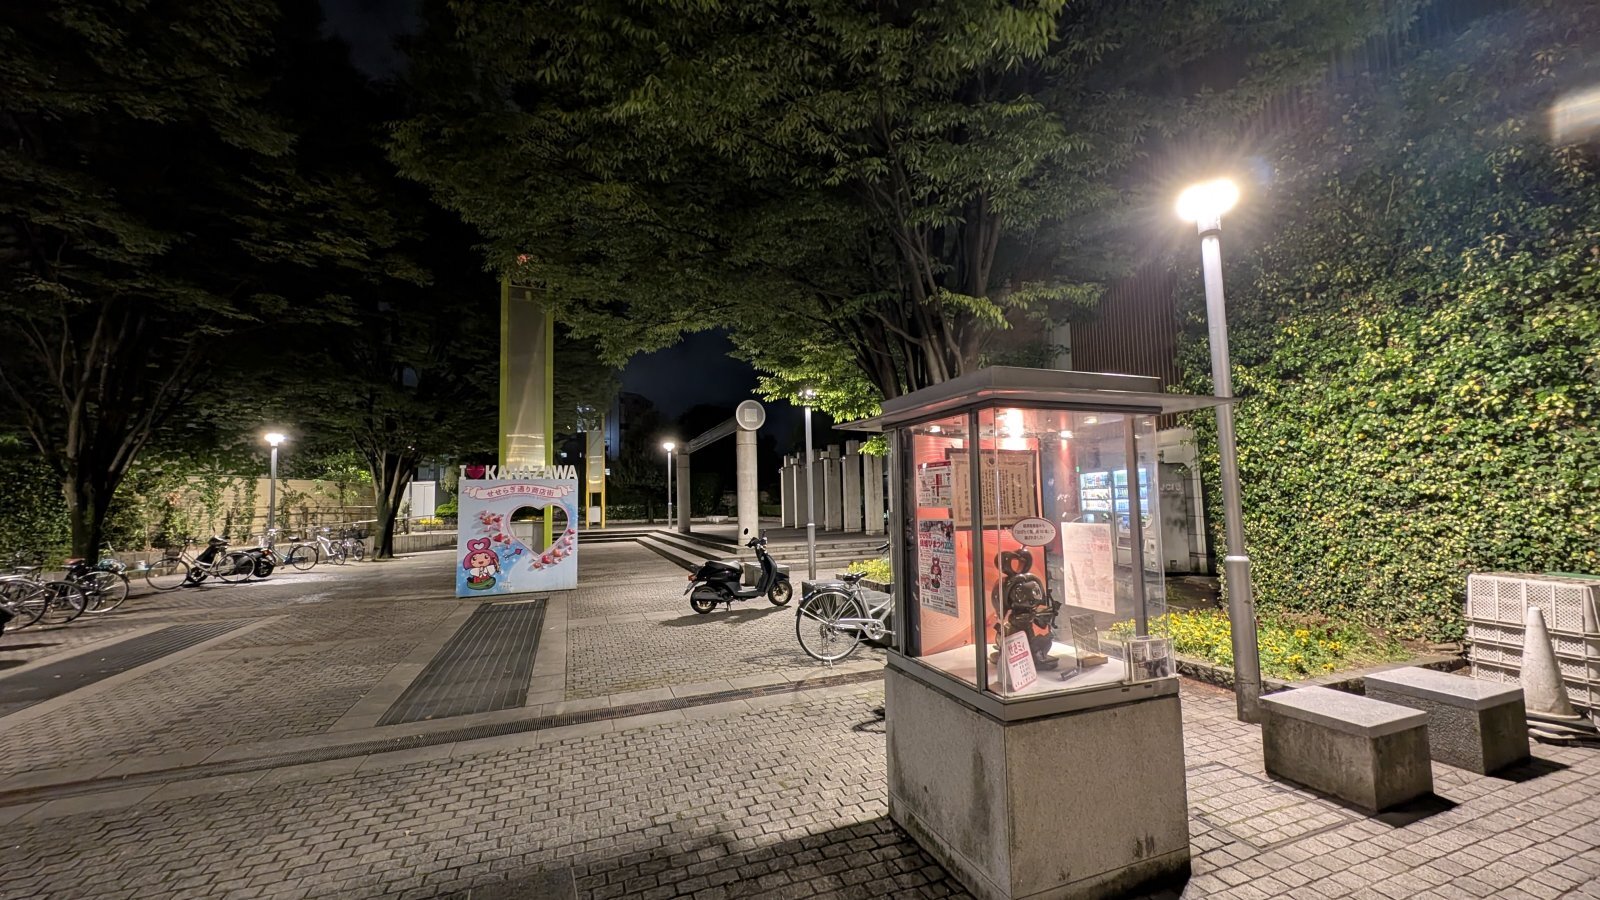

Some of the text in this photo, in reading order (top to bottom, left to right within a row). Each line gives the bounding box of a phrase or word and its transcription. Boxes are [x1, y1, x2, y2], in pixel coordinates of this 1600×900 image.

[459, 464, 578, 480] I KANAZAWA
[487, 484, 554, 497] せせらぎ通り商店街
